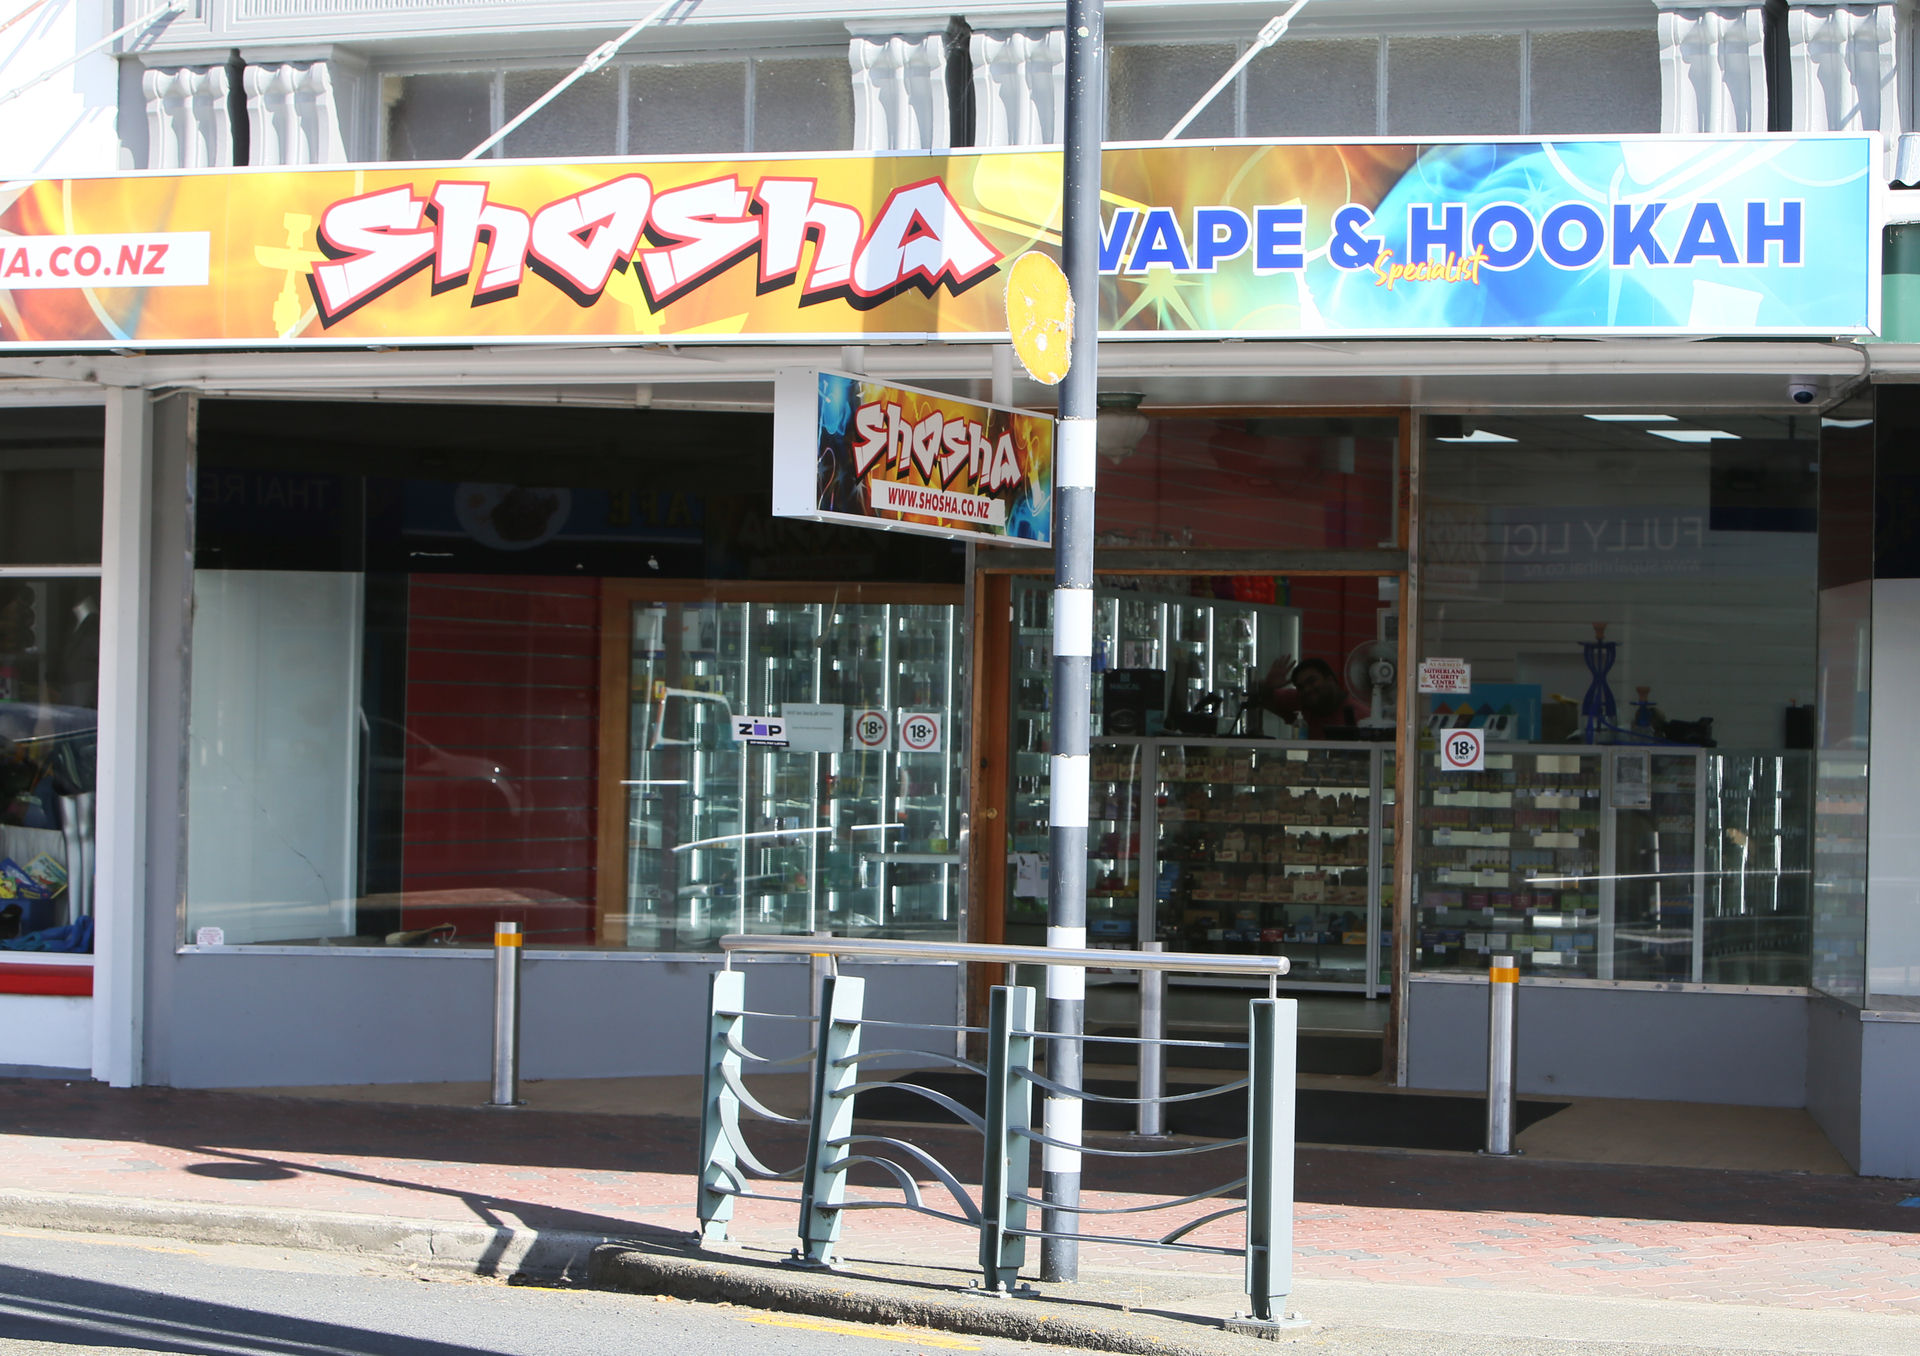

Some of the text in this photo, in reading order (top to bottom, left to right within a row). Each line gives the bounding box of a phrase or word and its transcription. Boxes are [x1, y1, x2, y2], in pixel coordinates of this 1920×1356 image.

[1098, 201, 1802, 271] VAPE & HOOKAH
[1374, 244, 1489, 290] Specialist
[888, 487, 989, 519] WWW.SHOSHA.CO.NZ
[862, 720, 883, 735] 18+
[909, 724, 932, 738] 18+
[1452, 741, 1475, 756] 18+
